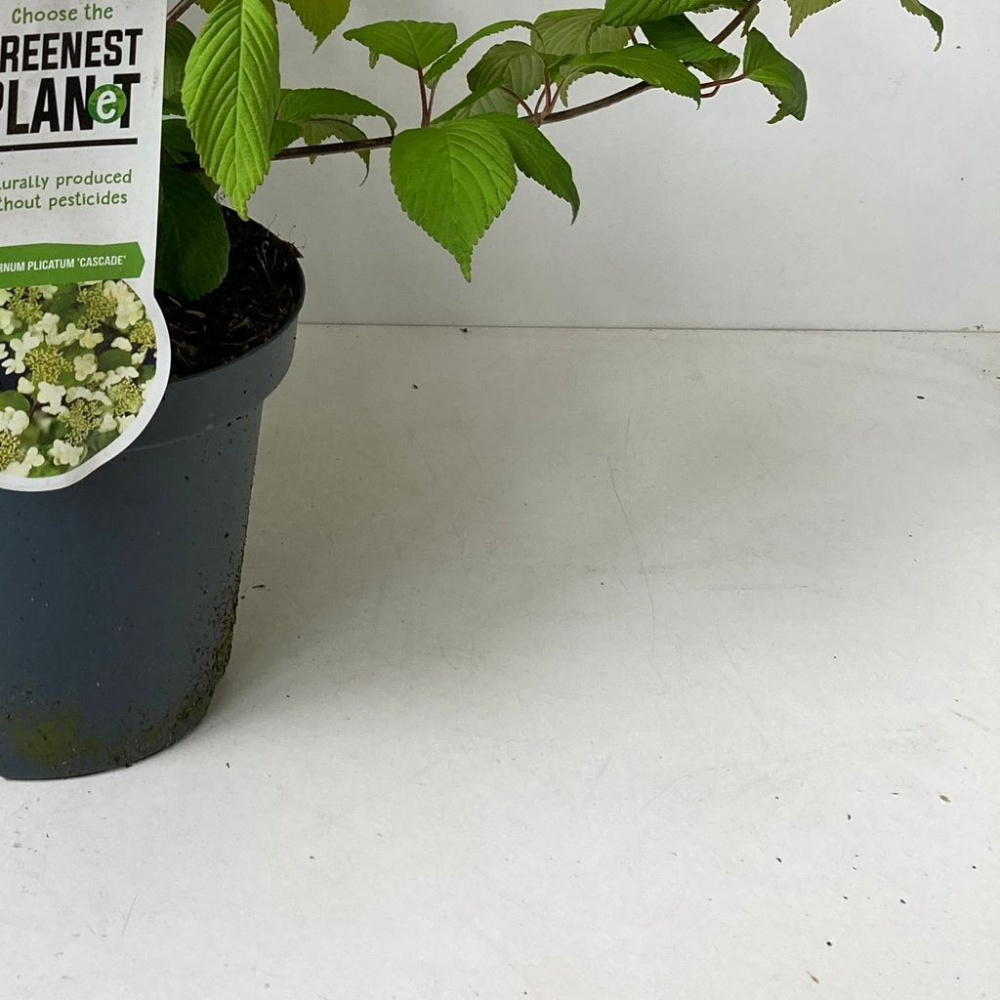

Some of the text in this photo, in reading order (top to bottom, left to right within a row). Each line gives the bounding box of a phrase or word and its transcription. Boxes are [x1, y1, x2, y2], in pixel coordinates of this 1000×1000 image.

[11, 3, 113, 24] Choose the
[56, 169, 132, 189] produced
[49, 191, 127, 210] pesticides
[27, 258, 74, 271] PLICATUM
